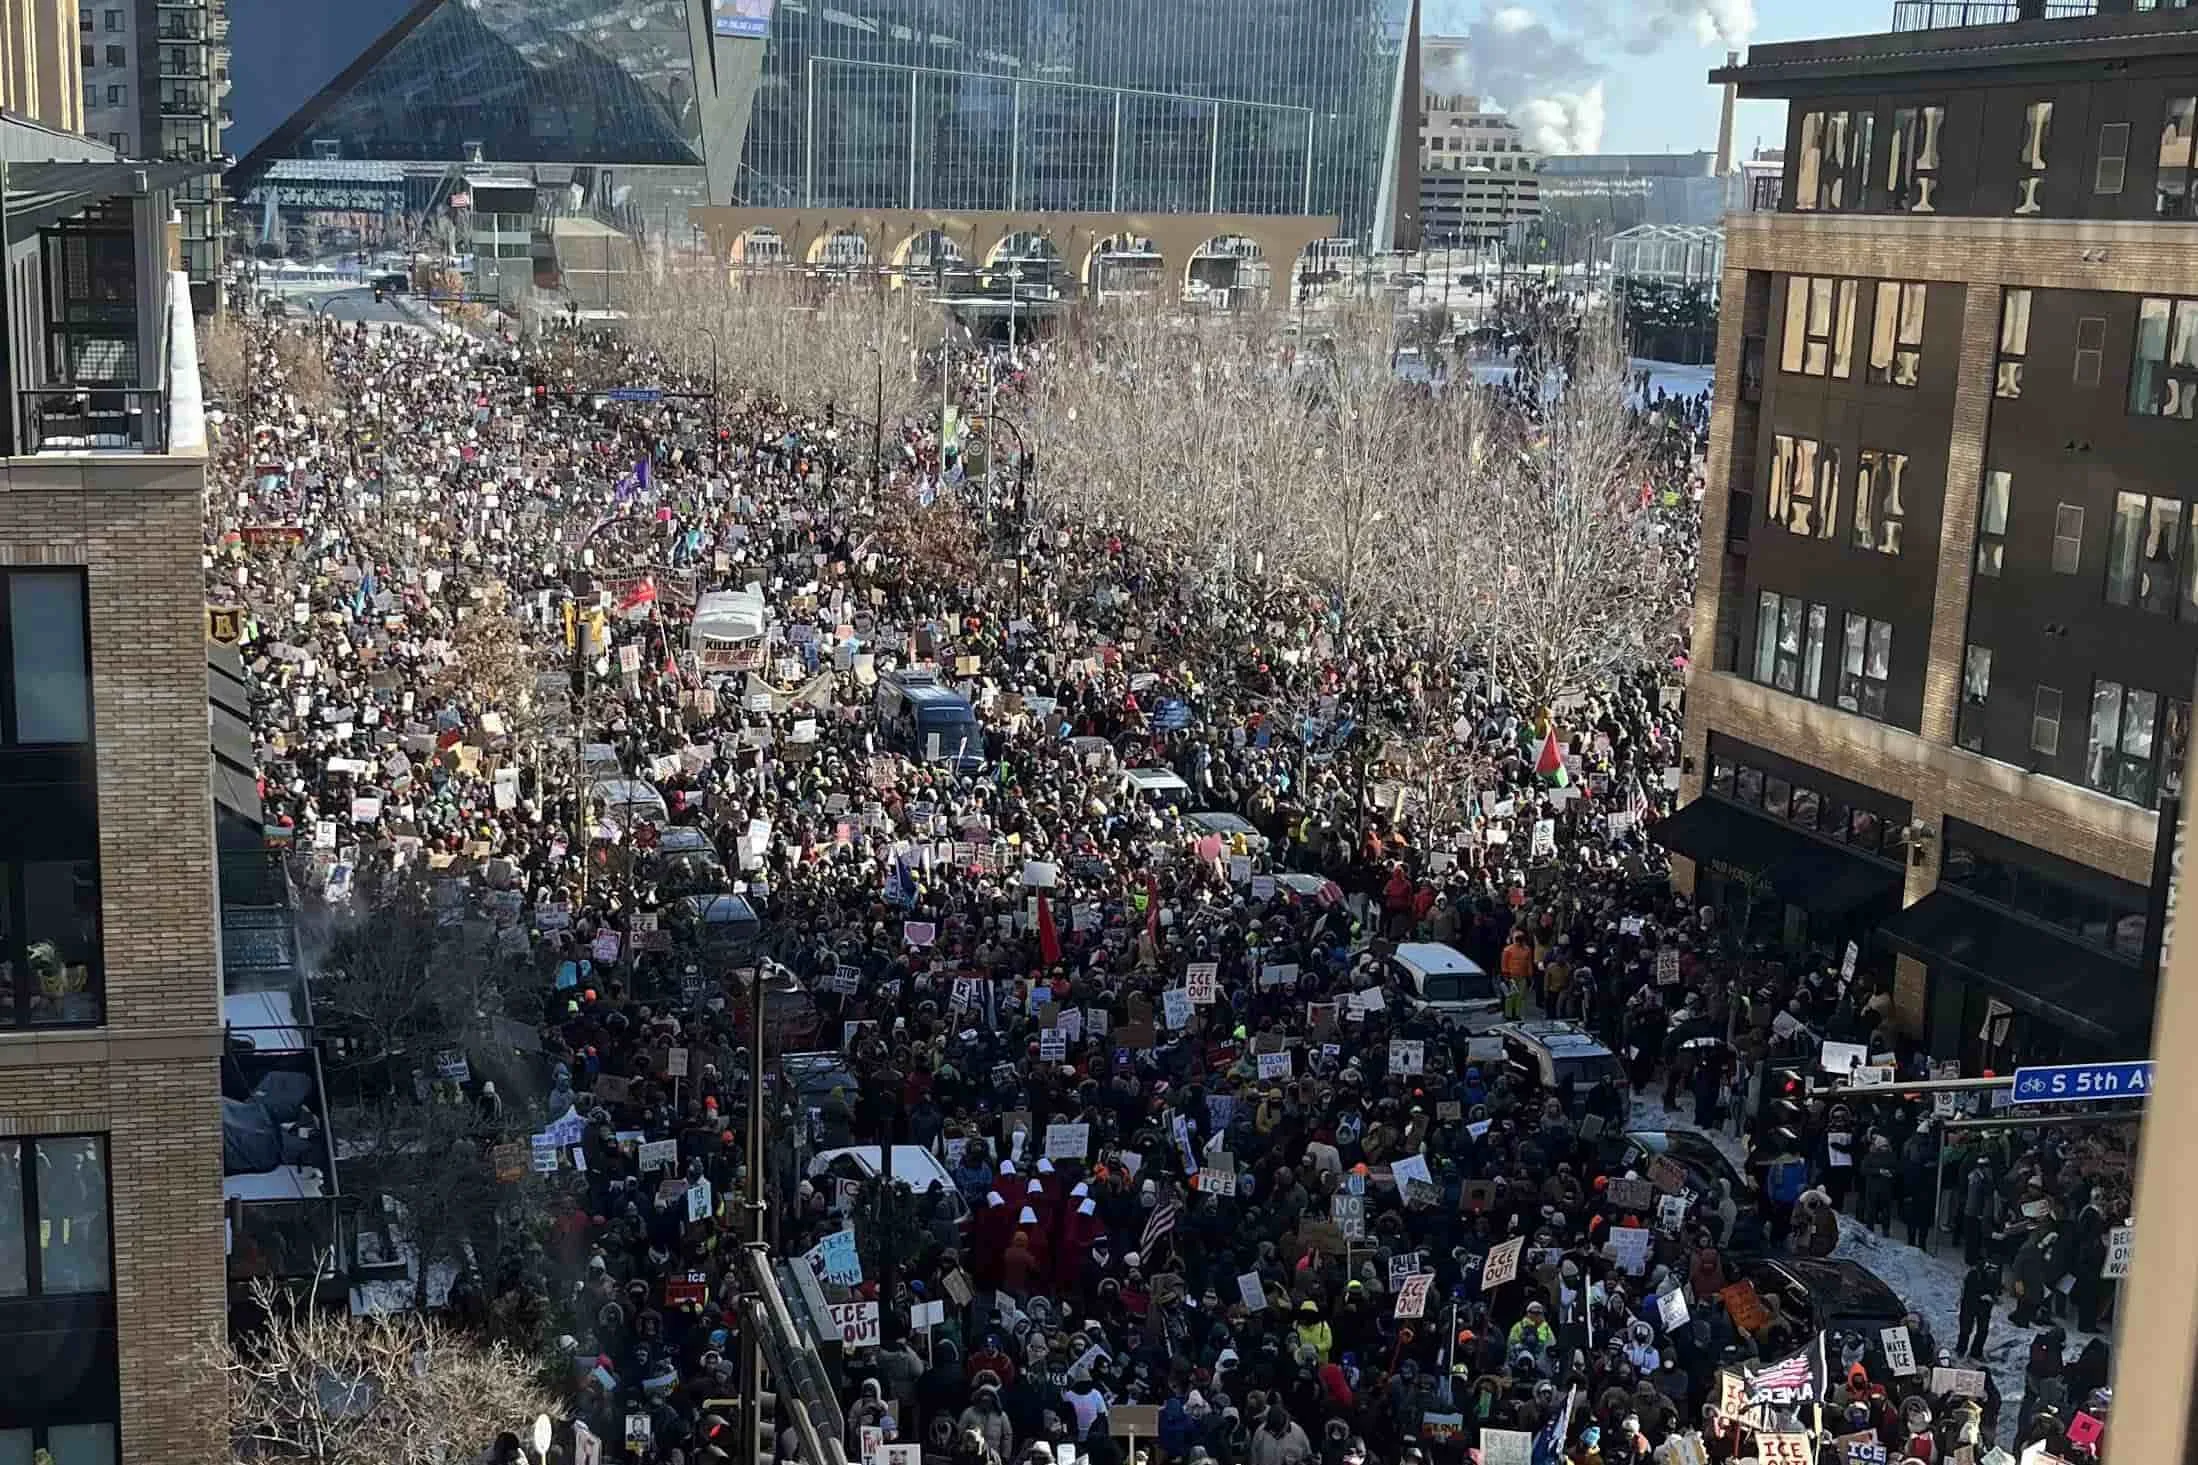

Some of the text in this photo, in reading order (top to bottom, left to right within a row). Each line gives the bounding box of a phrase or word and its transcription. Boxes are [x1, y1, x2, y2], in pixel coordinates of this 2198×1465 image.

[705, 639, 760, 650] KILLER ICE
[837, 966, 859, 979] STOP
[1190, 974, 1212, 985] ICE
[2051, 1074, 2066, 1093] S
[2076, 1072, 2118, 1092] 5th
[839, 1180, 860, 1196] IC
[1336, 1198, 1361, 1217] NO
[1489, 1250, 1515, 1268] ICE
[687, 1272, 706, 1283] ICE
[830, 1303, 867, 1326] ICE
[843, 1319, 878, 1342] OUT
[1887, 1341, 1907, 1352] HATE
[1892, 1353, 1911, 1368] ICE
[1763, 1440, 1803, 1458] ICE
[1847, 1440, 1886, 1463] ICE
